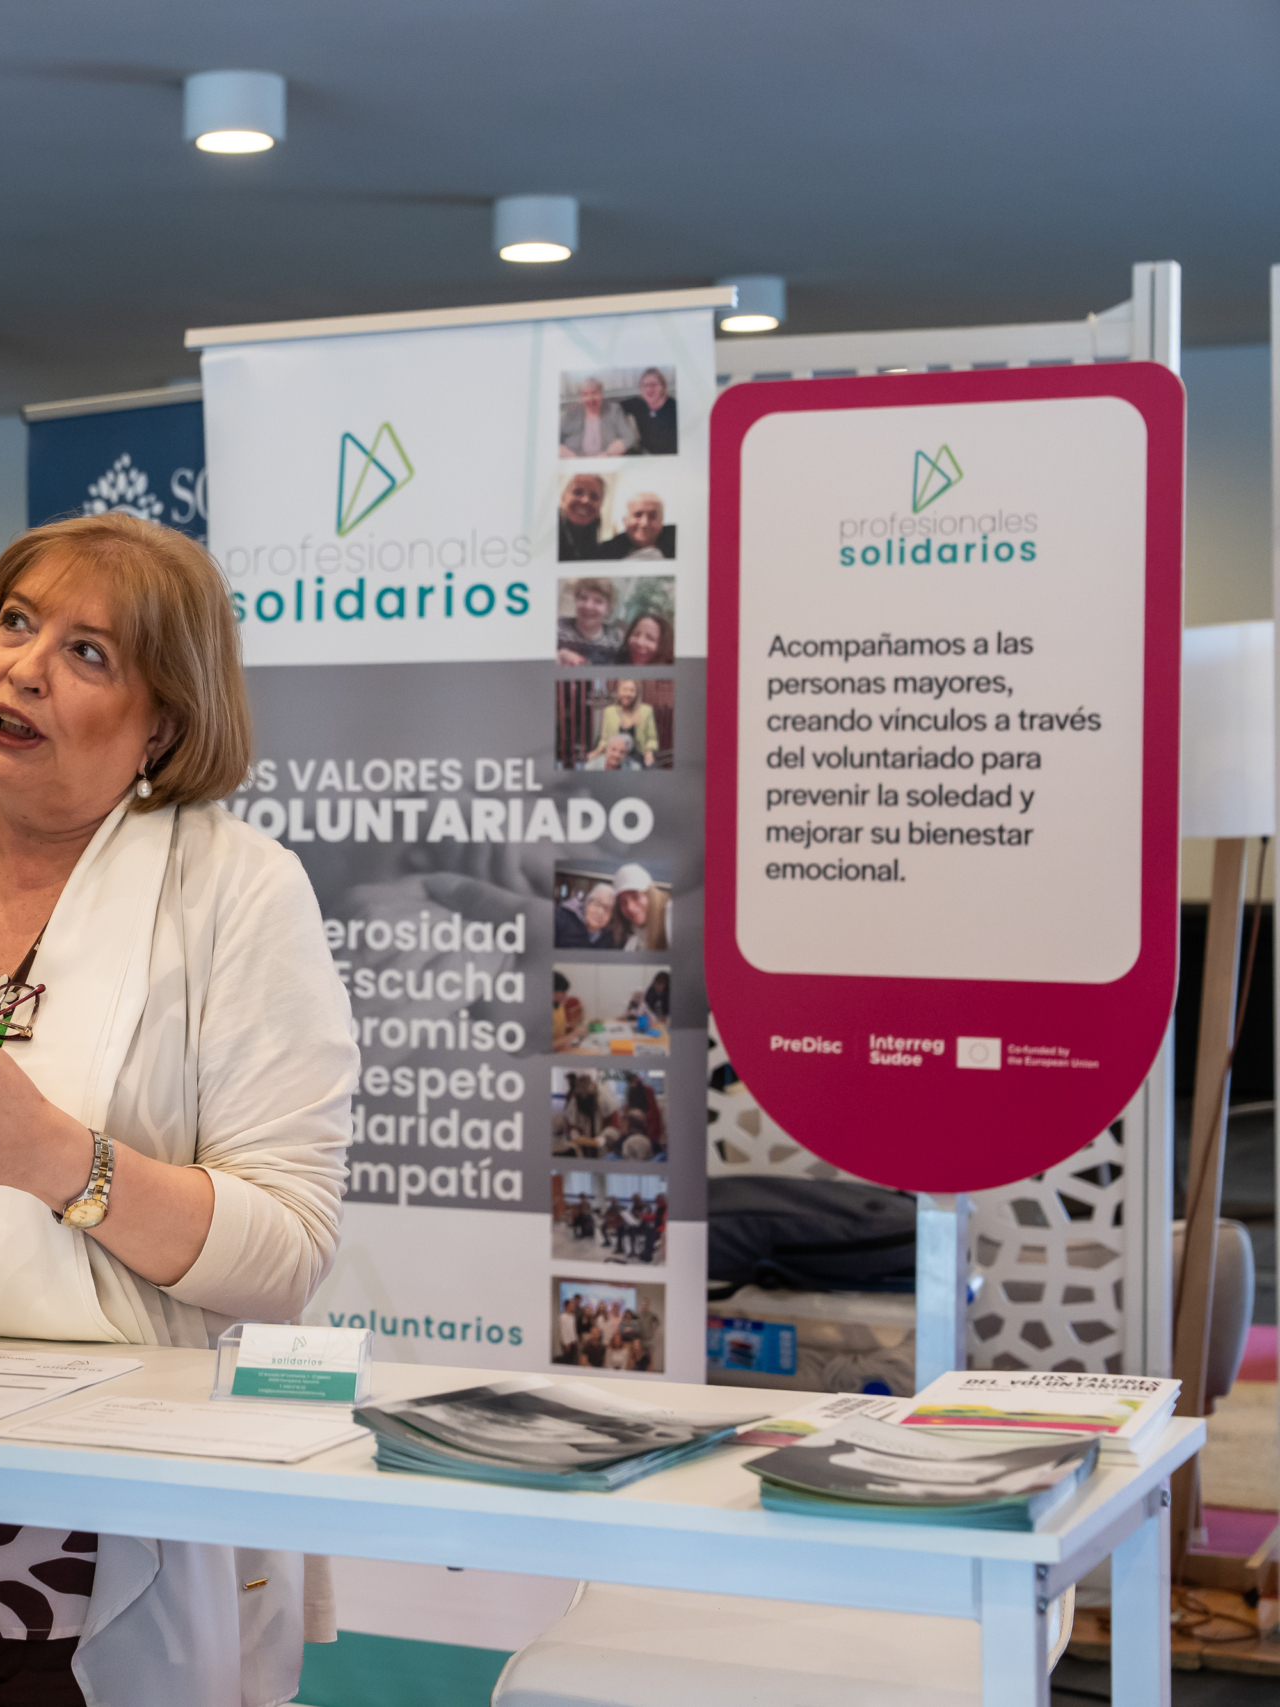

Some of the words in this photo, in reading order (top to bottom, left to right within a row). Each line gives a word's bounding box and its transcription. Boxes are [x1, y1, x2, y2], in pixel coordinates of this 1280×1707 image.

[839, 508, 1039, 544] profesionales
[225, 529, 531, 580] profesionales
[839, 535, 1038, 568] solidarios
[229, 573, 531, 624] solidarios
[768, 632, 966, 662] Acompañamos
[973, 638, 989, 656] a
[996, 631, 1034, 656] las
[767, 674, 886, 701] personas
[893, 673, 1014, 700] mayores,
[766, 708, 873, 733] creando
[879, 706, 987, 732] vínculos
[995, 713, 1011, 732] a
[1019, 706, 1102, 732] través
[288, 758, 462, 793] VALORES
[475, 758, 543, 792] DEL
[767, 747, 805, 770] del
[812, 746, 974, 771] voluntariado
[981, 751, 1042, 775] para
[766, 784, 870, 812] prevenir
[877, 783, 899, 807] la
[906, 784, 1012, 808] soledad
[1019, 789, 1035, 814] y
[765, 822, 863, 849] mejorar
[871, 827, 901, 846] su
[908, 821, 1034, 846] bienestar
[765, 859, 906, 882] emocional.
[324, 911, 526, 953] erosidad
[351, 1011, 526, 1053] romiso
[770, 1035, 842, 1054] PreDisc
[870, 1034, 945, 1055] Interreg
[870, 1051, 923, 1066] Sudoe
[1024, 1056, 1070, 1067] European
[1070, 1059, 1100, 1069] Union
[1058, 1047, 1070, 1058] by
[352, 1064, 526, 1113] espeto
[351, 1108, 524, 1150] daridad
[345, 1158, 524, 1206] mpatía
[328, 1310, 525, 1347] voluntarios
[271, 1356, 323, 1367] solidarios
[1010, 1379, 1158, 1392] VOLUNTARIADO
[1077, 1375, 1162, 1387] VALORES
